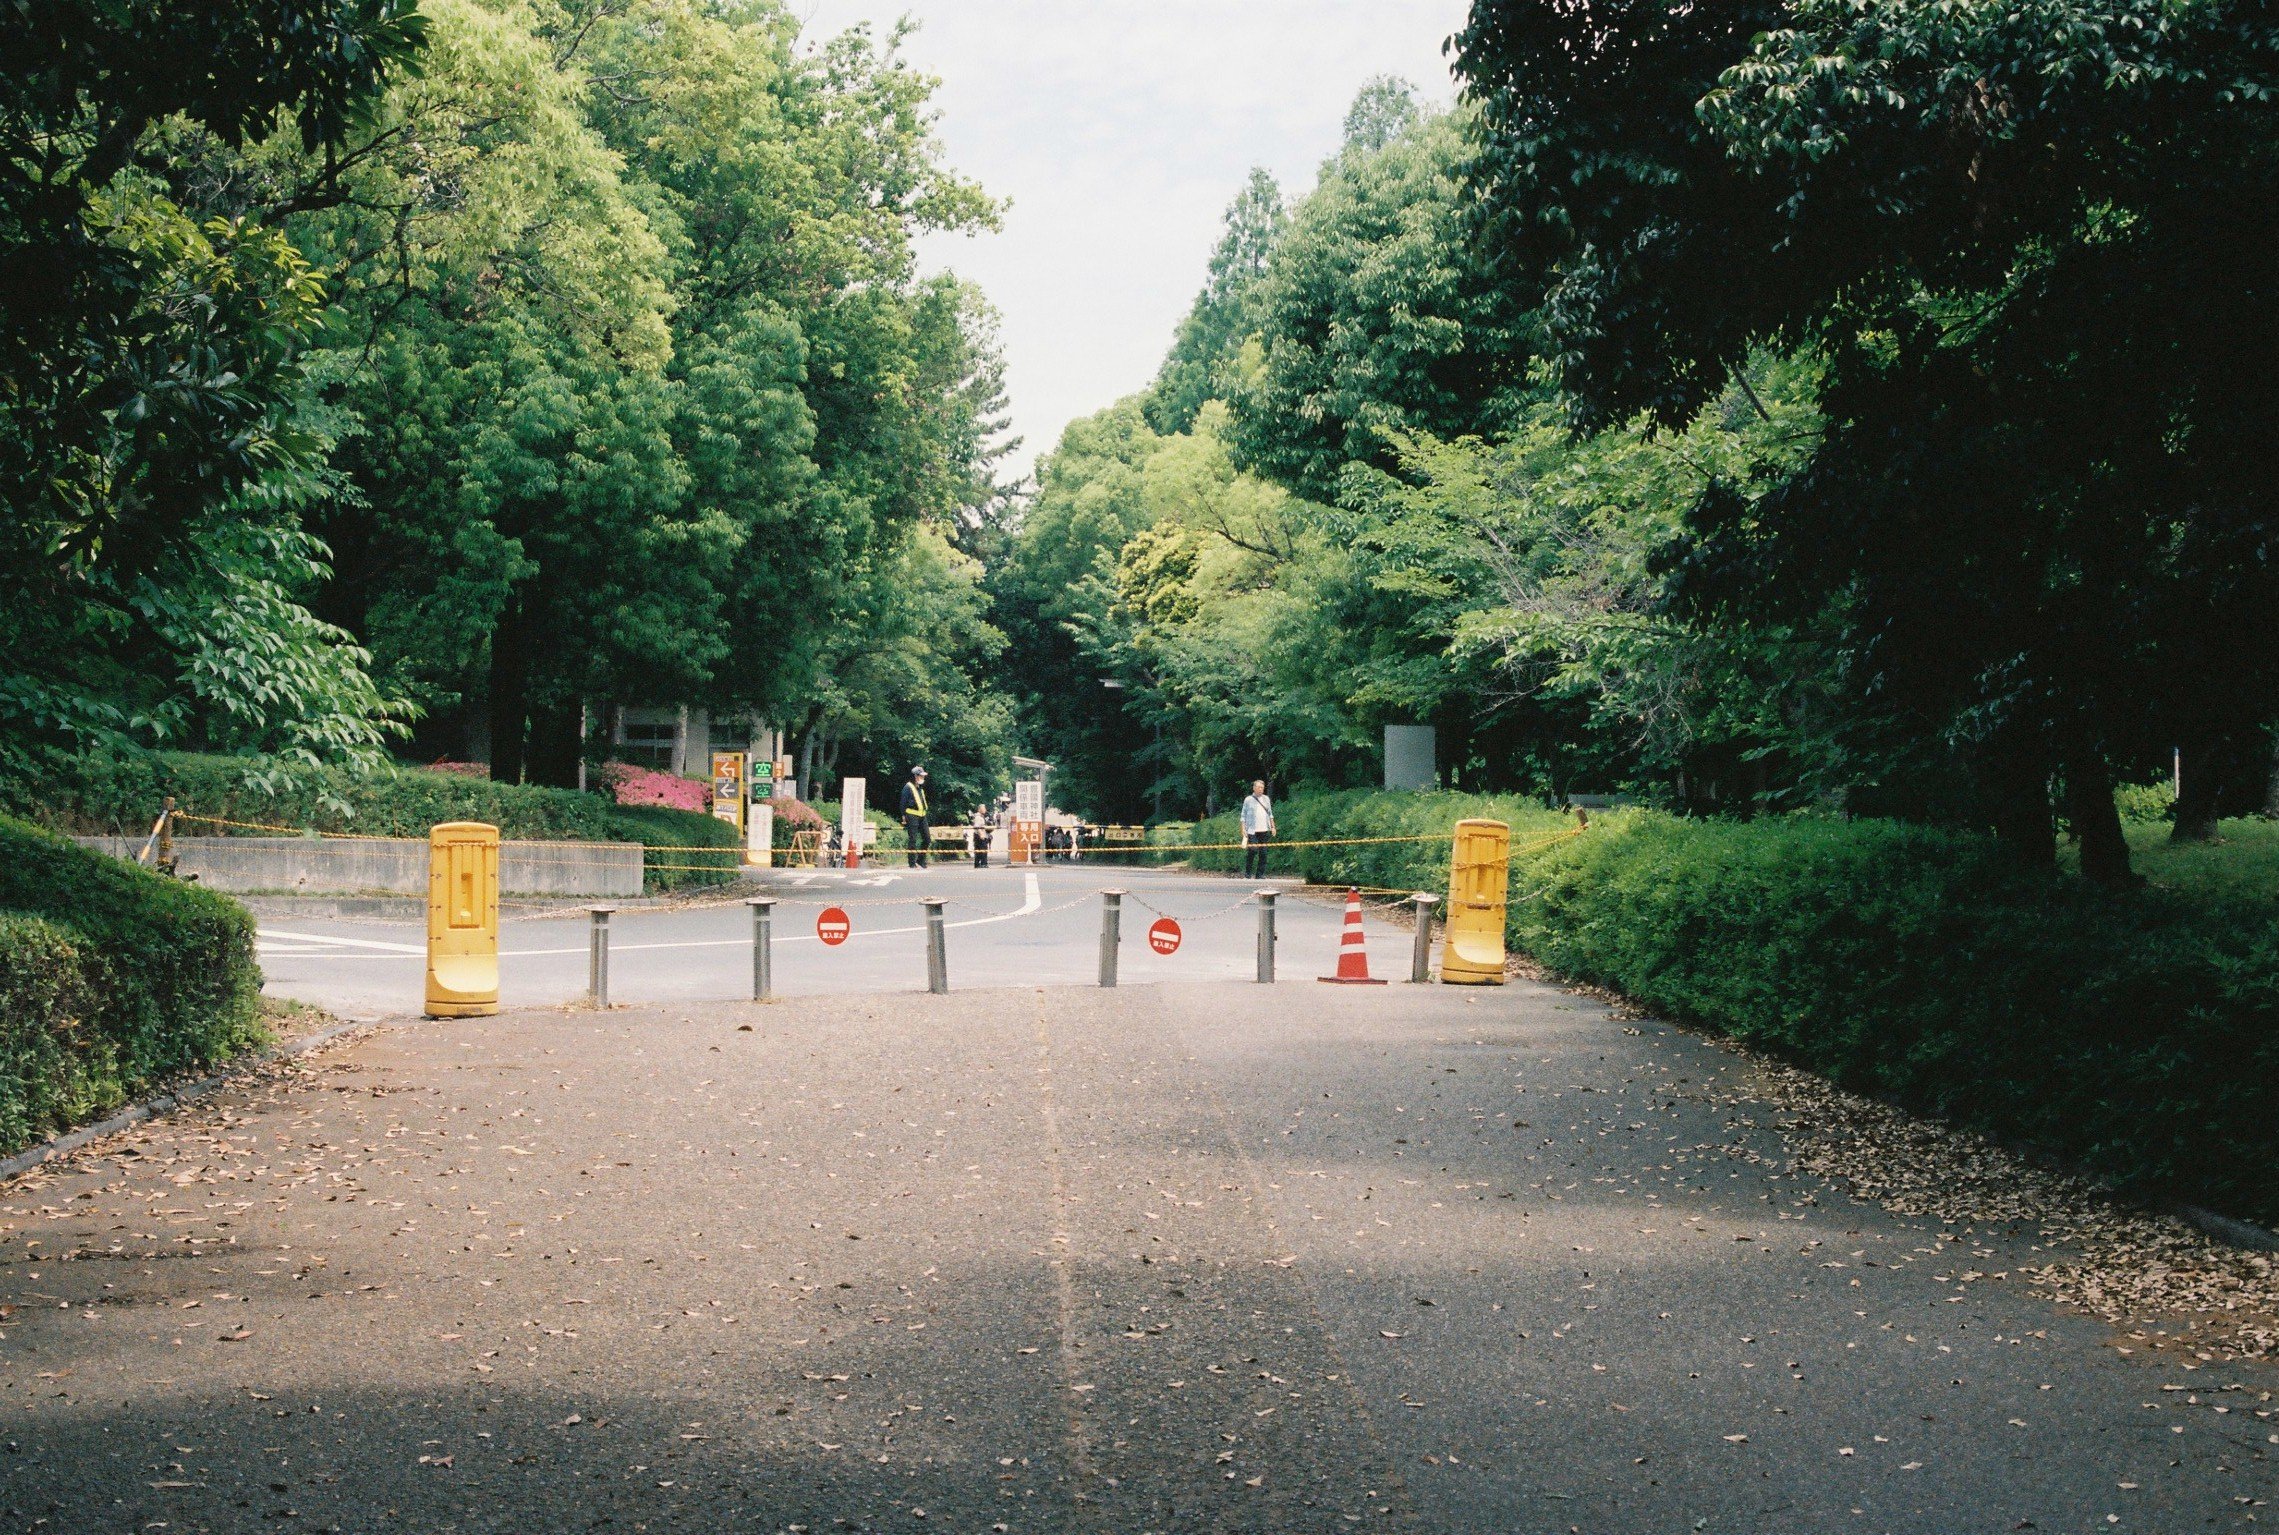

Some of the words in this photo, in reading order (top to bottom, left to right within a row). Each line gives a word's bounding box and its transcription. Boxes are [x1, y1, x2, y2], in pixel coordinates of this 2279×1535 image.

[755, 762, 771, 777] 空
[1020, 822, 1039, 832] 専用
[1020, 833, 1039, 842] 入口
